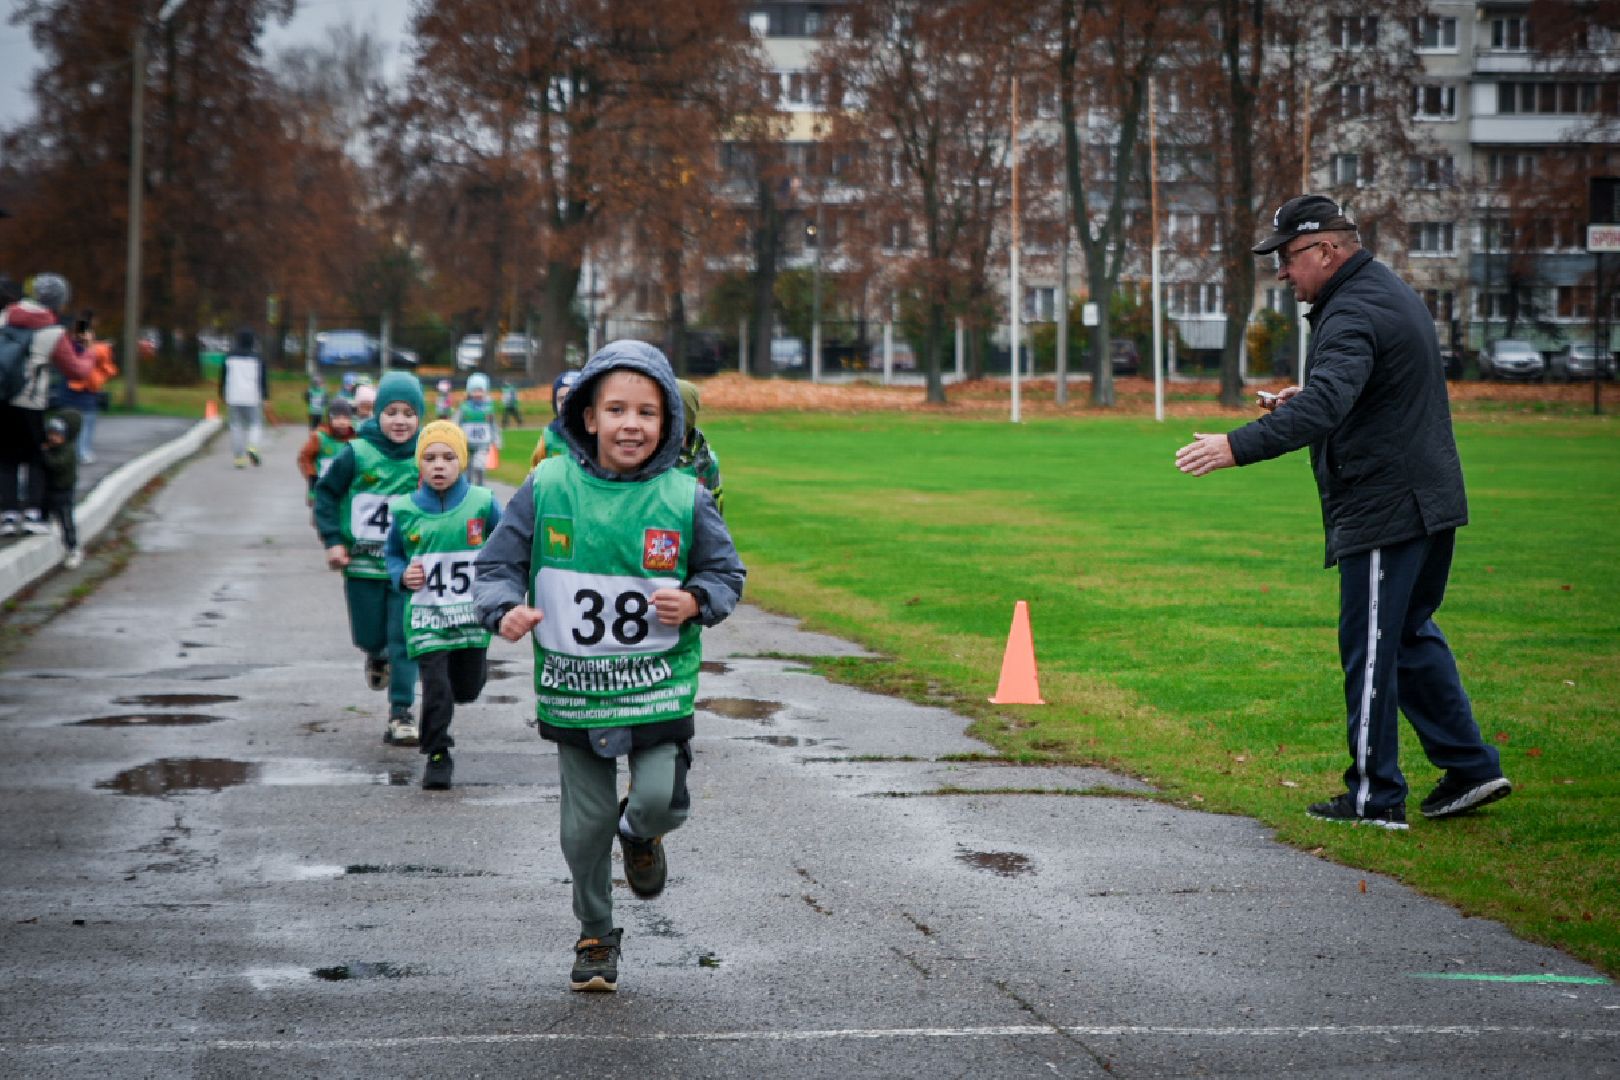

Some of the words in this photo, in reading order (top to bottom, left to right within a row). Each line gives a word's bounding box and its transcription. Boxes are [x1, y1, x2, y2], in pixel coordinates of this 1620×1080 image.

[426, 561, 471, 597] 45
[571, 588, 649, 646] 38
[540, 658, 672, 692] БРОННИЦЫ
